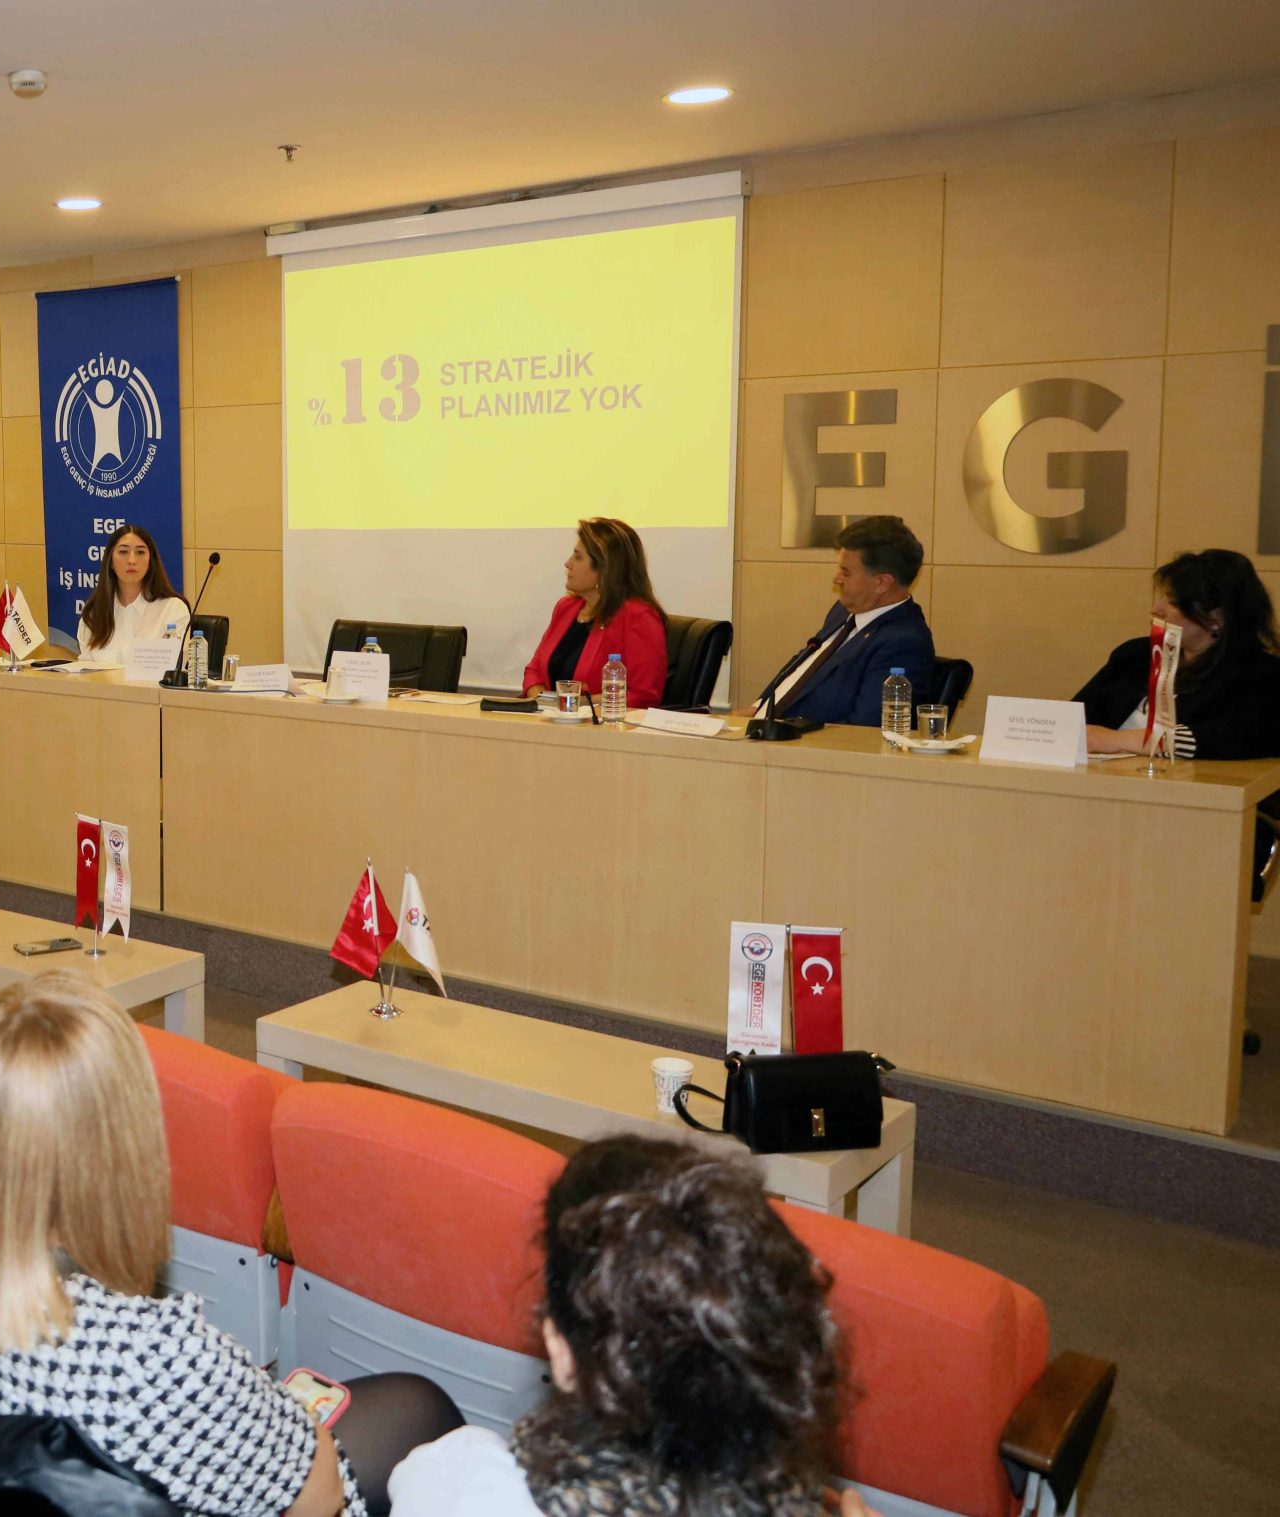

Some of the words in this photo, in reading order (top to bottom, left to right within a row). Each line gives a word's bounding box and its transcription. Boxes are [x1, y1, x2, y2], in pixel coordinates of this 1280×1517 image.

[77, 351, 131, 384] EGİAD
[439, 348, 595, 386] STRATEJİK
[440, 389, 572, 420] PLANIMIZ
[579, 383, 644, 412] YOK
[60, 446, 71, 467] EGE
[69, 467, 88, 490] GENÇ
[87, 481, 95, 495] İŞ
[95, 480, 135, 498] İNSANLARI
[134, 443, 158, 486] DERNEĞİ
[100, 472, 117, 481] 1990
[59, 566, 73, 590] İŞ
